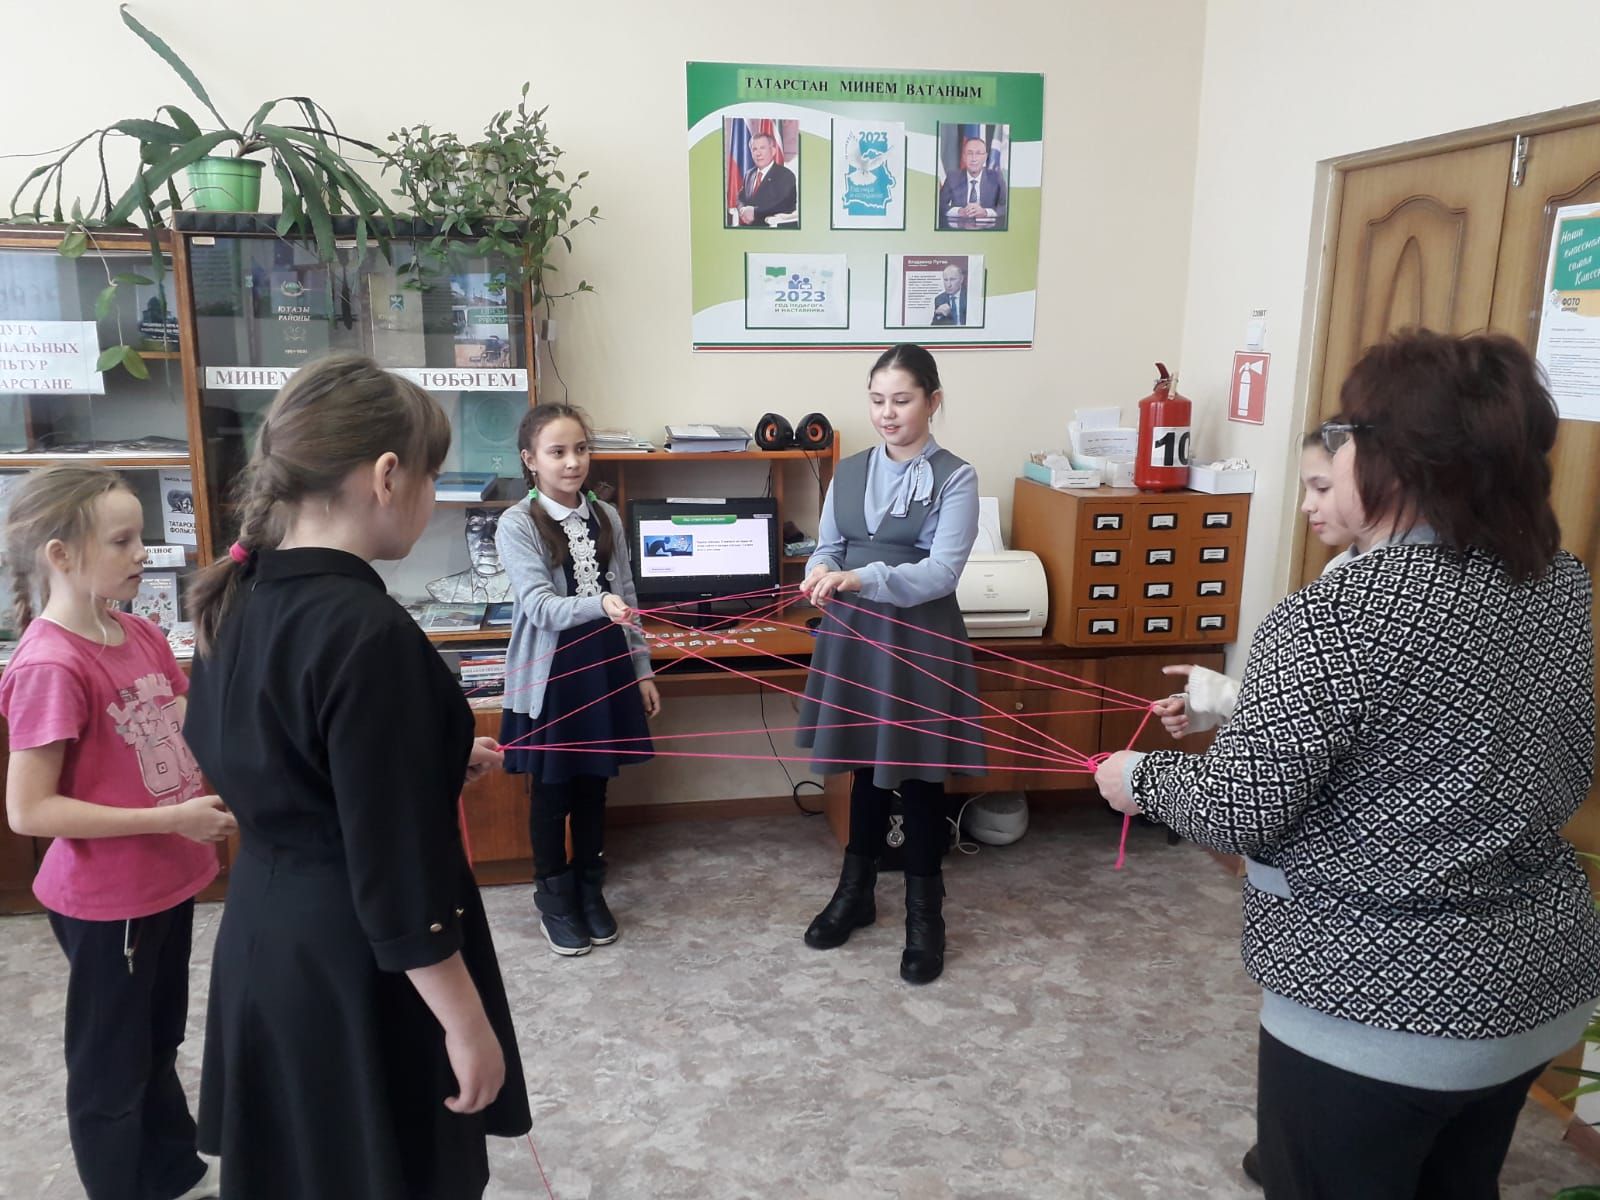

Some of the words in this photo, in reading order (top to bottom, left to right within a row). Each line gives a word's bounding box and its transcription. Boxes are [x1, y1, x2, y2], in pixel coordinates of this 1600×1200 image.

[745, 77, 828, 92] ТАТАРСТАН
[840, 80, 897, 94] МИНЕМ
[906, 83, 982, 98] ВАТАНЫМ
[859, 131, 888, 143] 2023
[774, 290, 826, 302] 2023
[1561, 297, 1581, 306] ФОТО
[277, 305, 311, 313] ЮТАЗЫ
[419, 373, 517, 387] ТӨБӘГЕМ
[1154, 431, 1191, 466] 10
